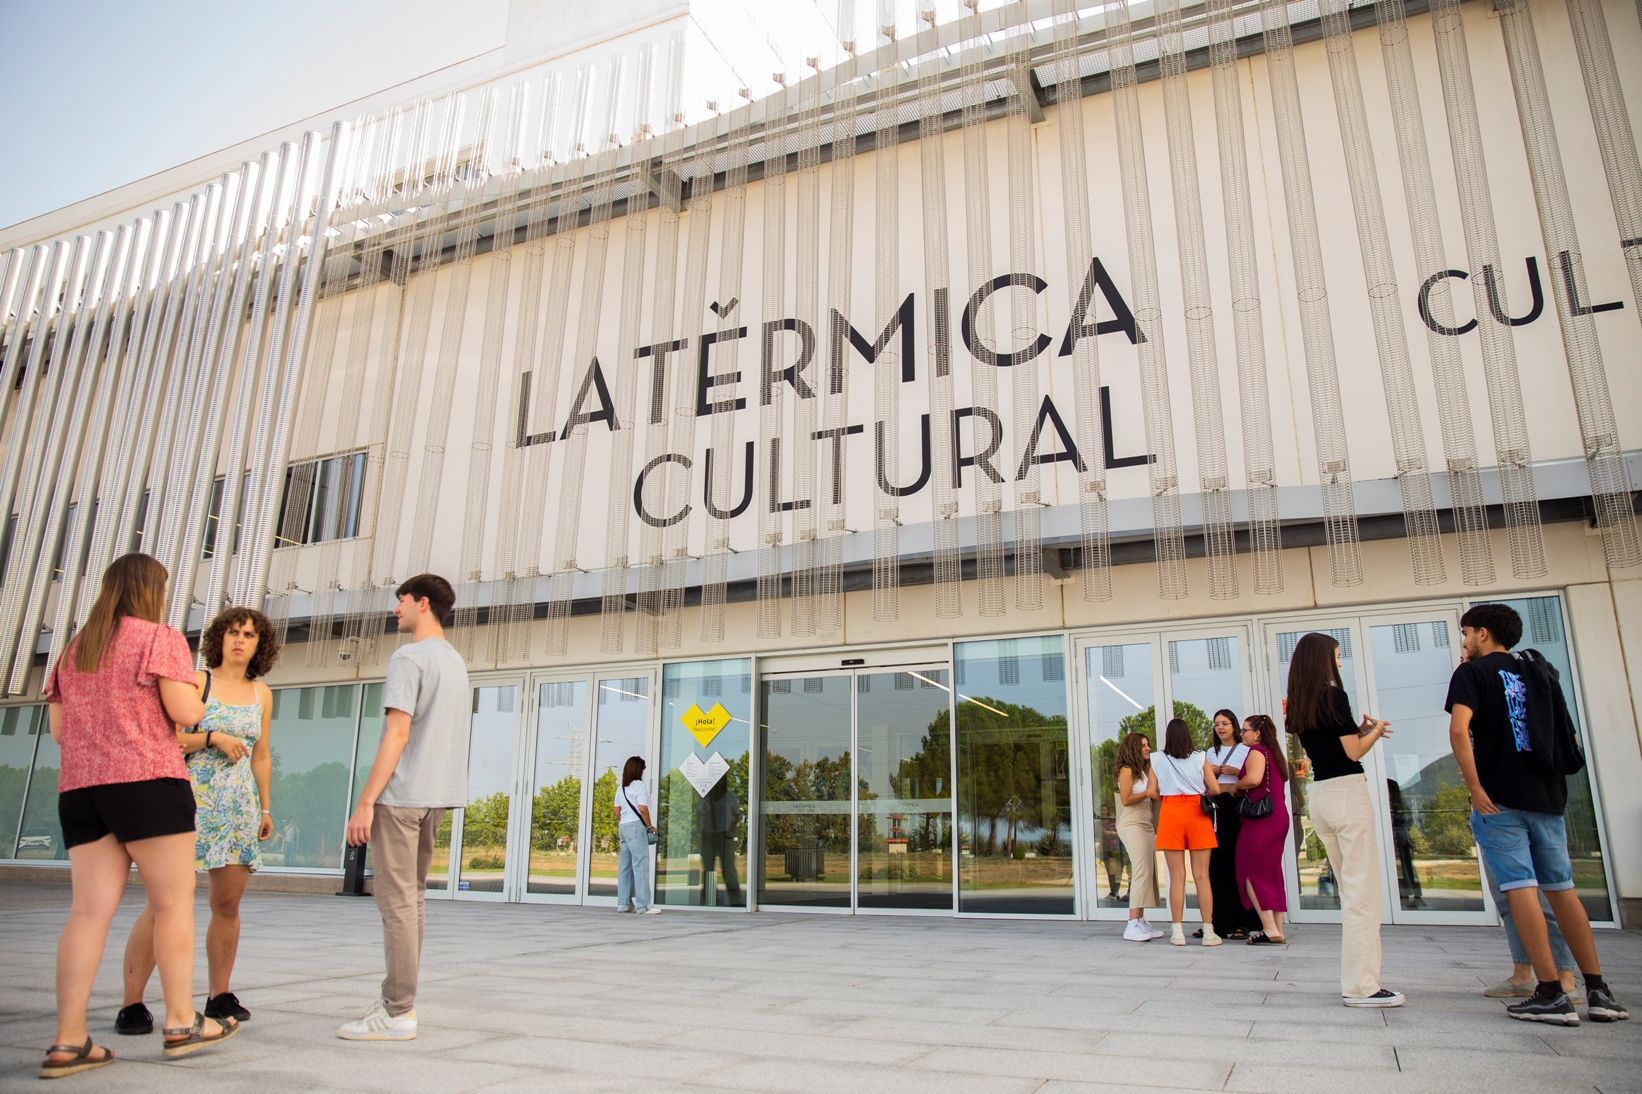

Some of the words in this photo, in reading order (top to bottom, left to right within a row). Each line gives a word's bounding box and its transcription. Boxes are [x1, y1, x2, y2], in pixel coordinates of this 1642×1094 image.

[1418, 237, 1642, 336] CUL
[633, 386, 1157, 527] CULTURAL
[695, 718, 715, 727] ¡Hola!
